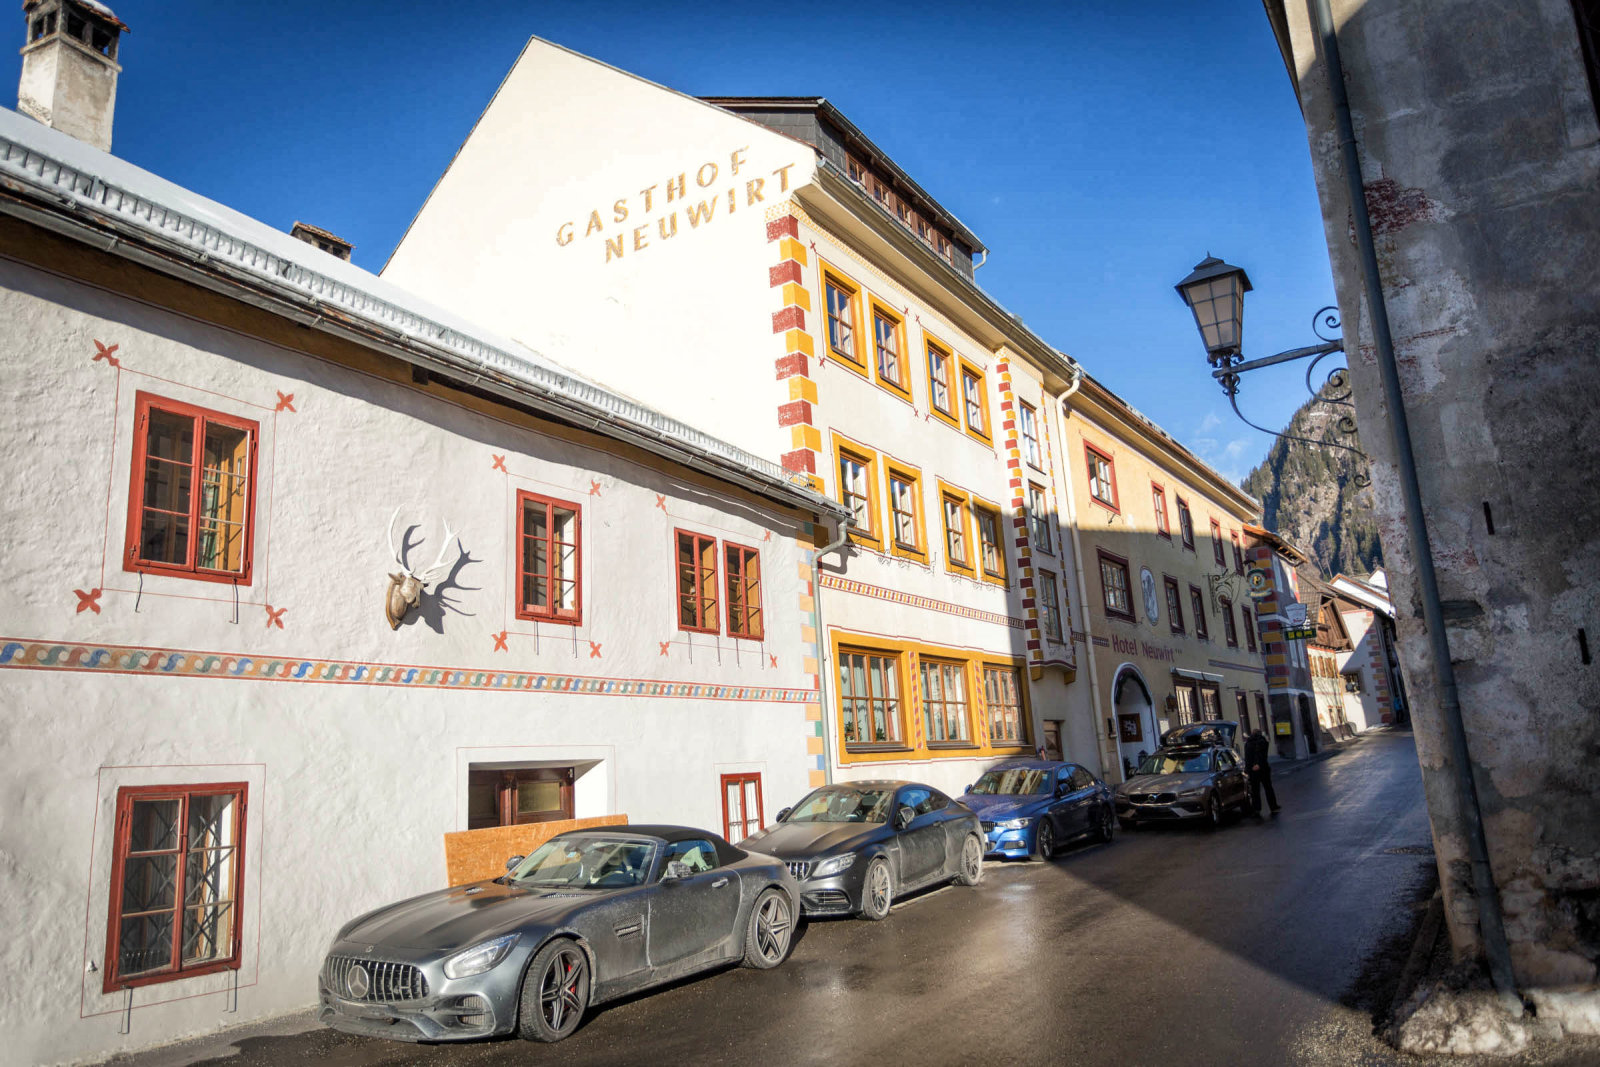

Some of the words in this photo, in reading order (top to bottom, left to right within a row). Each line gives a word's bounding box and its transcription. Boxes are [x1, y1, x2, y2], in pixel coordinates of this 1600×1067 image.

[556, 145, 750, 247] GASTHOF
[605, 162, 796, 264] NEUWIRT
[1111, 633, 1138, 656] Hotel
[1141, 640, 1175, 662] Neuwirt
